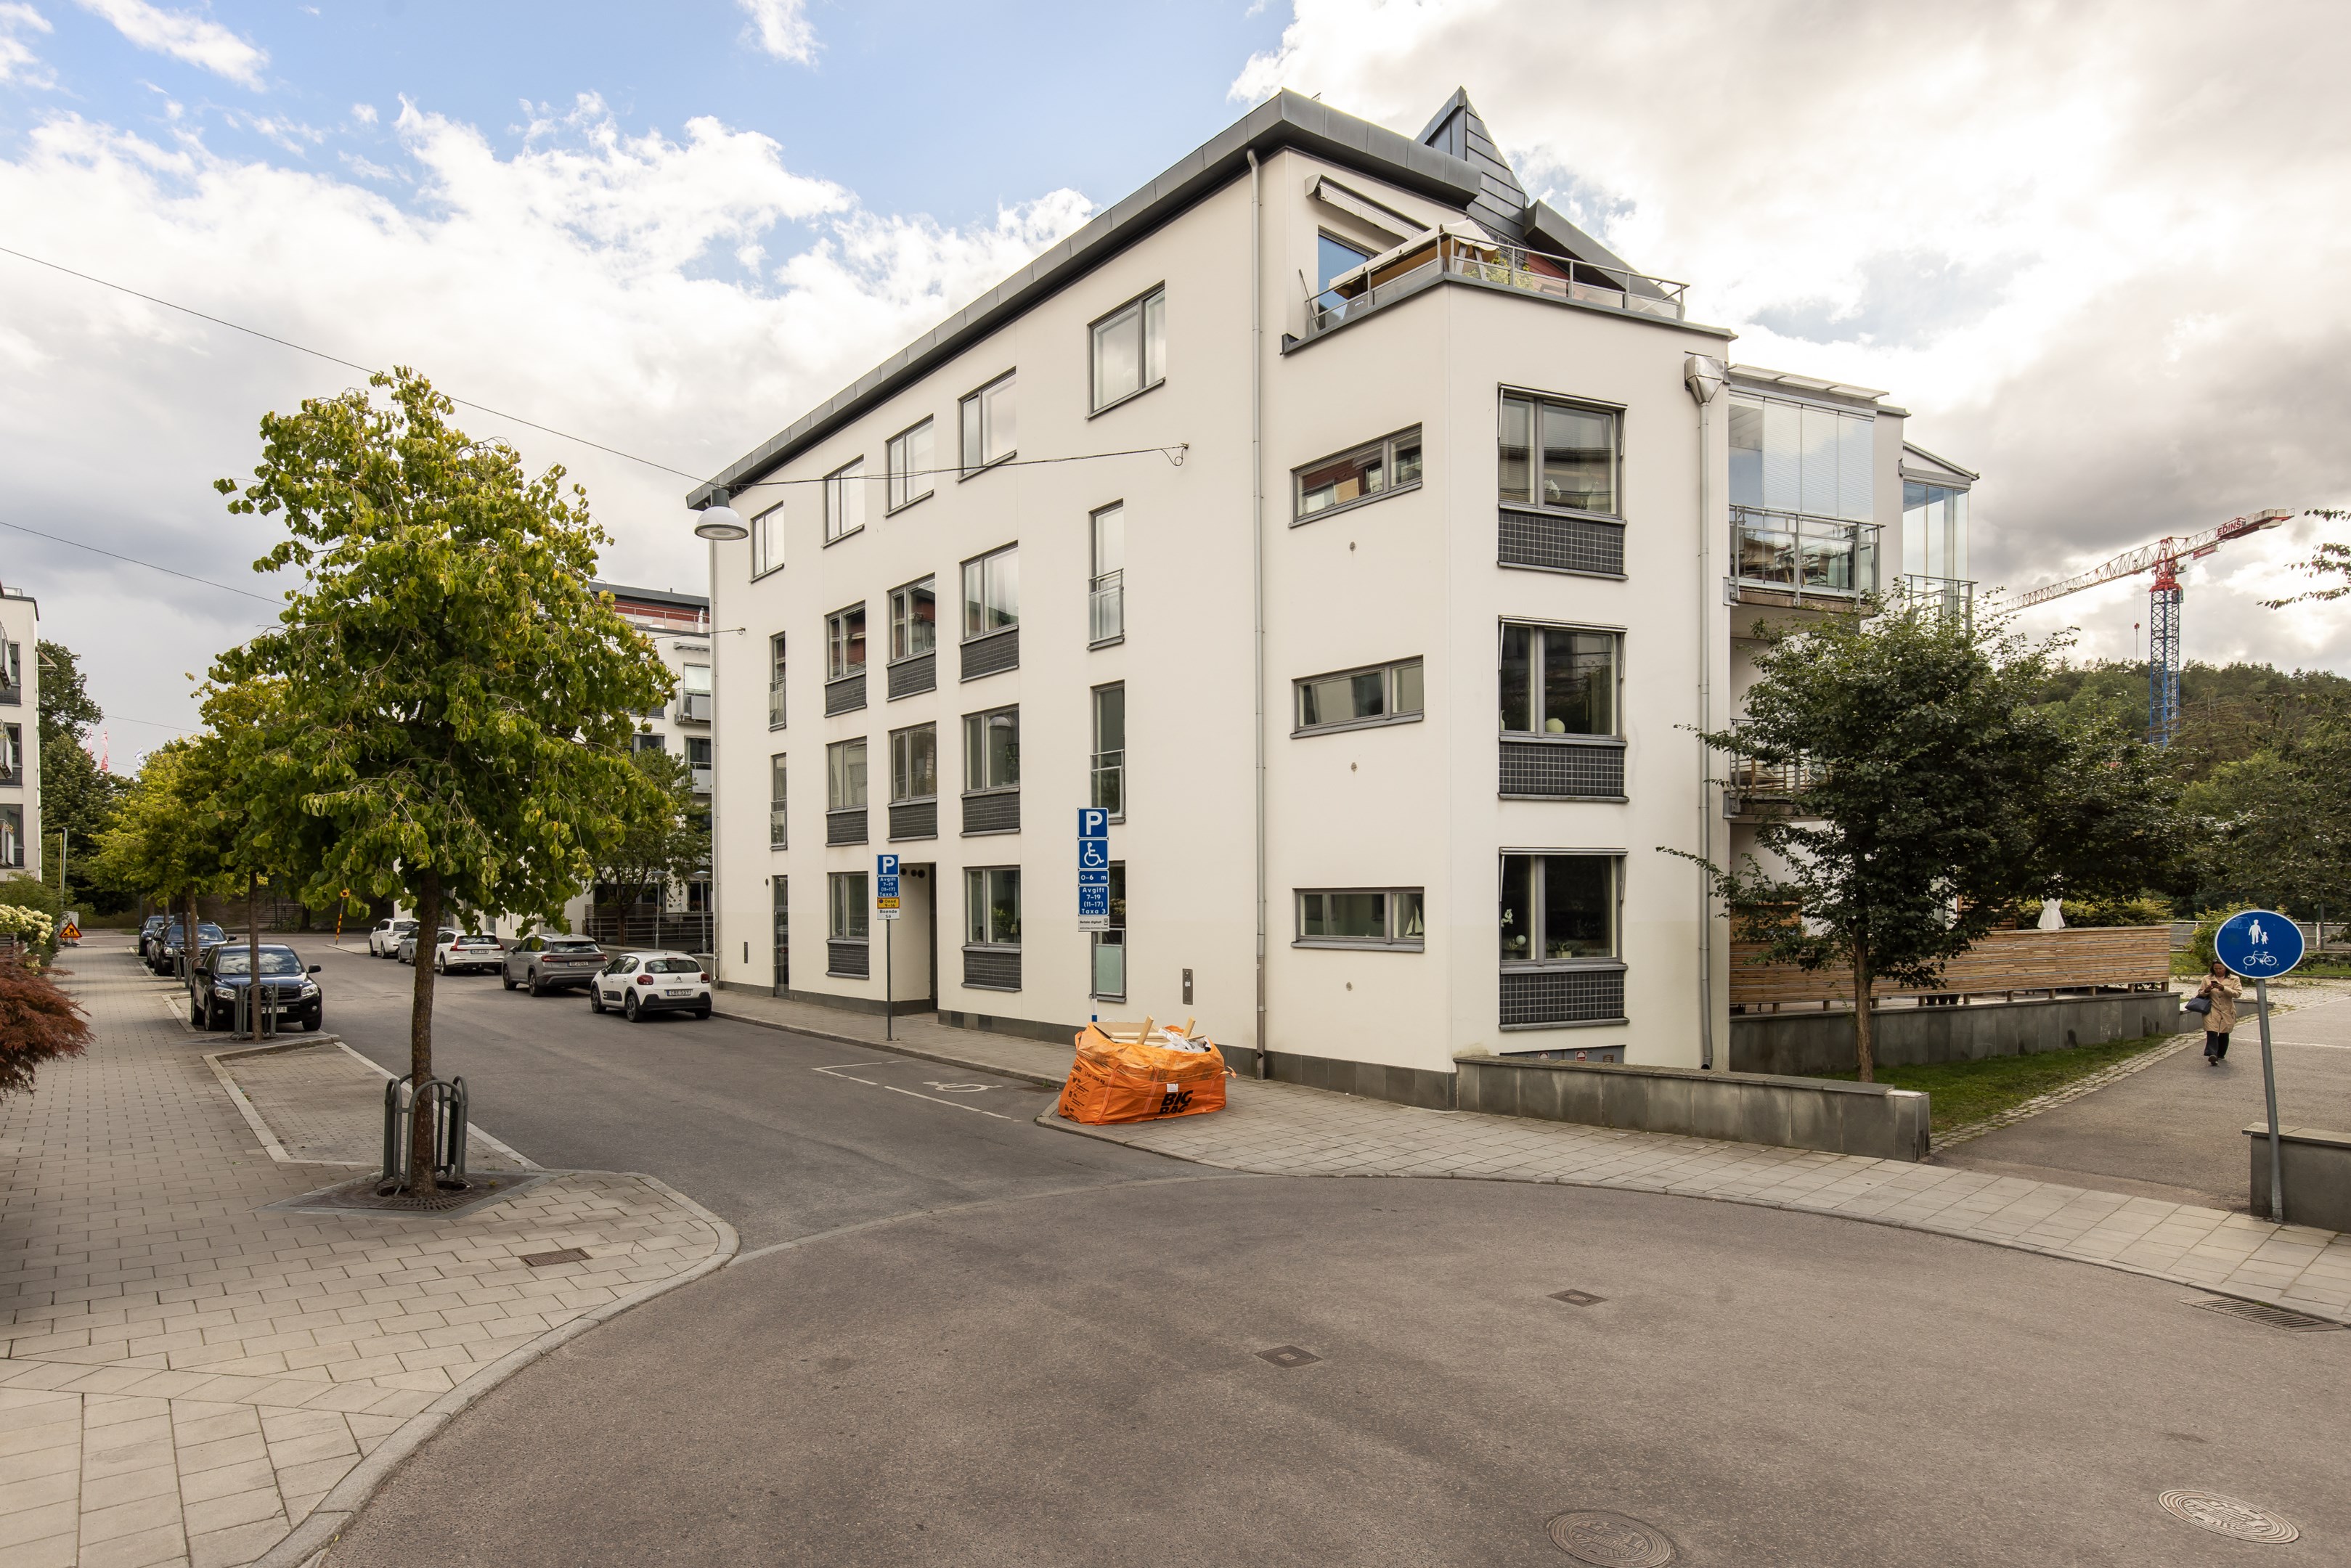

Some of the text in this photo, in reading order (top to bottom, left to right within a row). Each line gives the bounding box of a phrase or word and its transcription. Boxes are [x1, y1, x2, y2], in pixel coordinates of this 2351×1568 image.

[2217, 520, 2241, 536] EDINS
[1086, 811, 1103, 835] P
[883, 857, 895, 874] P
[1161, 1090, 1194, 1107] BIG
